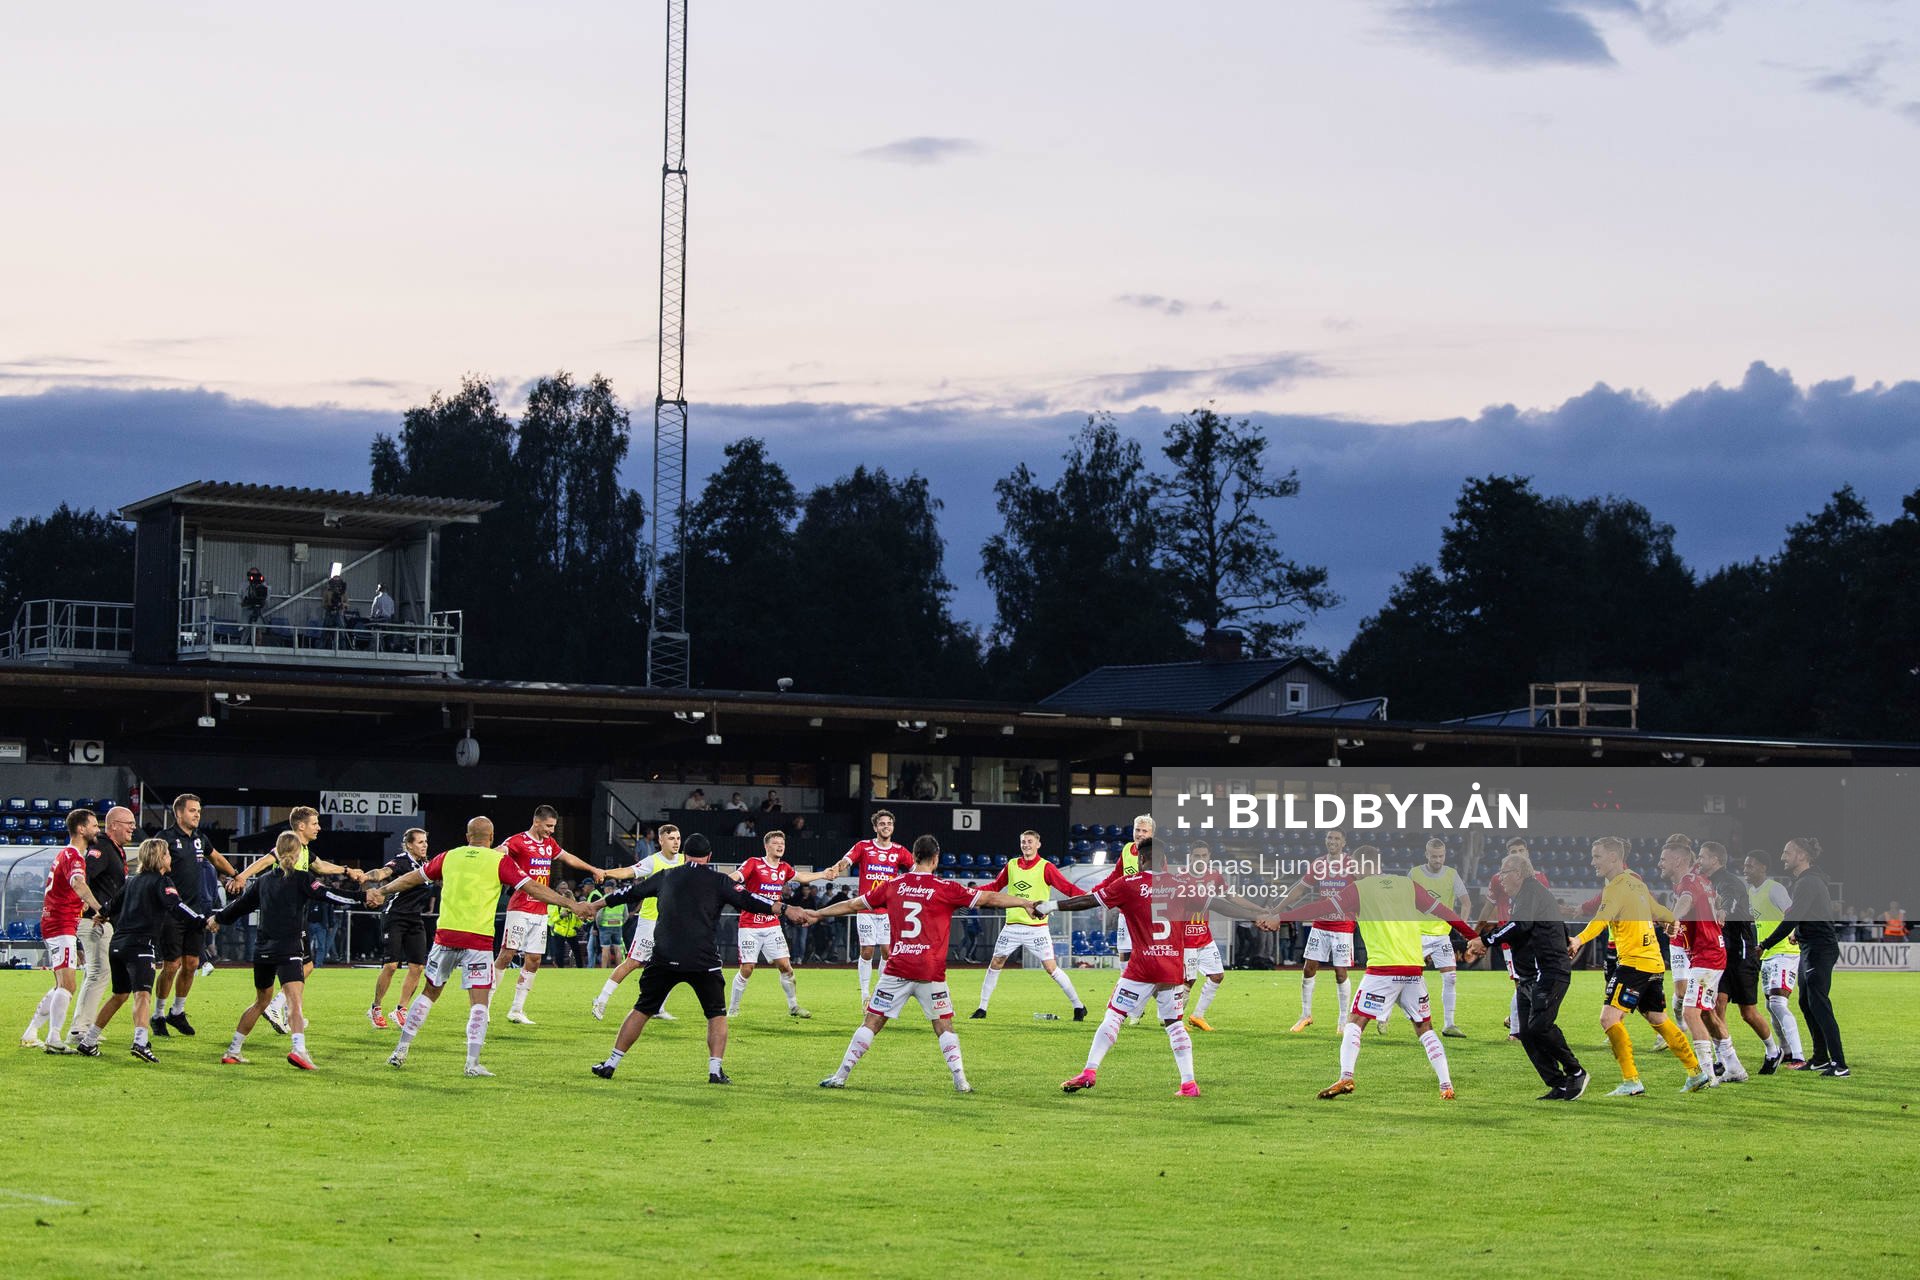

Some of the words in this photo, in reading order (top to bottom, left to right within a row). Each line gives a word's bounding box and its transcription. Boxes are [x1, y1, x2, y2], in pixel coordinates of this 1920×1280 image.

[83, 741, 100, 762] C
[327, 799, 369, 814] A.B.C
[378, 800, 402, 814] D.E
[962, 814, 972, 828] D
[901, 901, 923, 938] 3
[1151, 903, 1172, 940] 5
